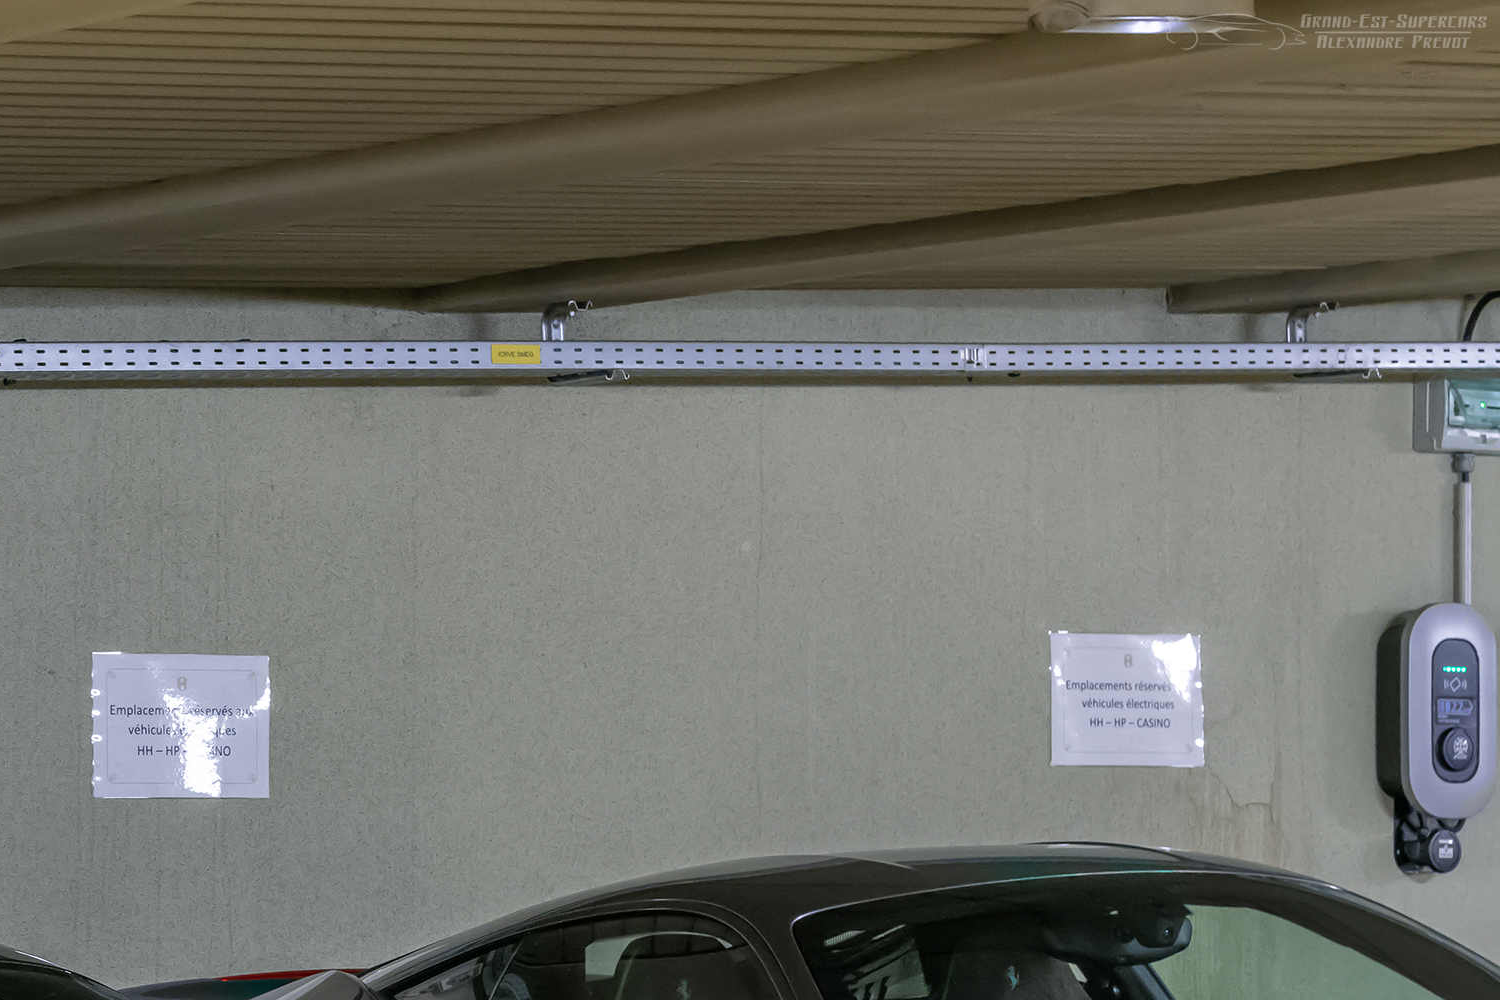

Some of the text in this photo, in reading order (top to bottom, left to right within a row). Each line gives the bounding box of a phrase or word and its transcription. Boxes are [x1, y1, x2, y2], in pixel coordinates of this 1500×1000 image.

[1066, 680, 1172, 692] Emplacements réservés
[1081, 698, 1175, 711] véhicules électriques
[1089, 718, 1104, 727] HH
[1114, 718, 1127, 728] HP
[1136, 718, 1171, 729] CASINO
[137, 745, 153, 756] HH
[165, 745, 180, 756] HP
